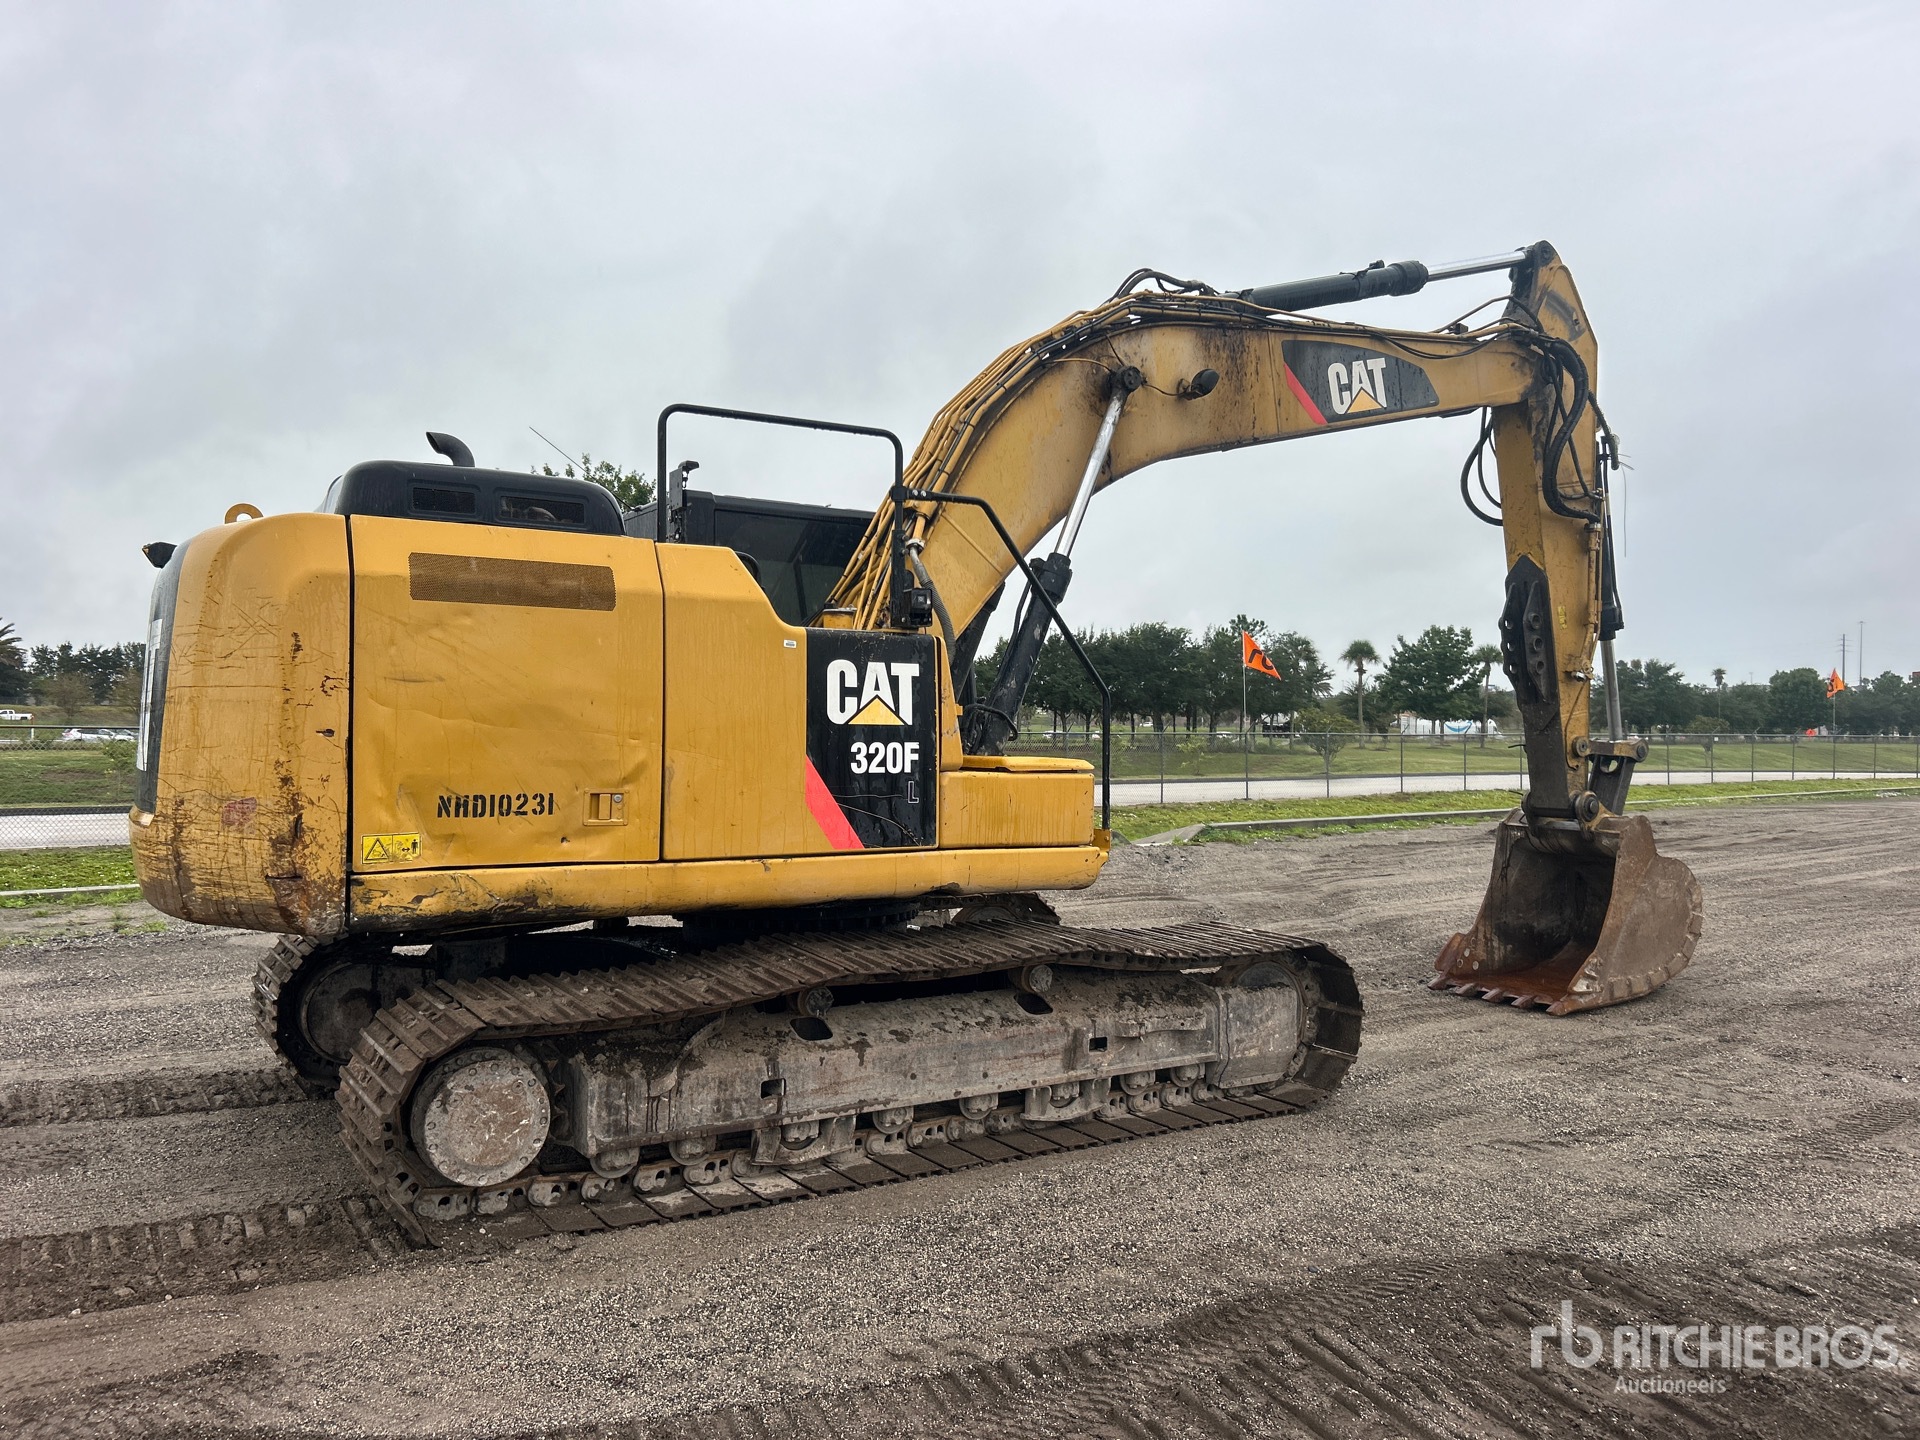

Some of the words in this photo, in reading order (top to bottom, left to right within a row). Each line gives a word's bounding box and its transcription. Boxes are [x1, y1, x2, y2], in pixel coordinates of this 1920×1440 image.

[1327, 357, 1387, 415] CAT
[826, 659, 920, 726] CAT
[850, 741, 920, 775] 320F
[907, 780, 920, 804] L
